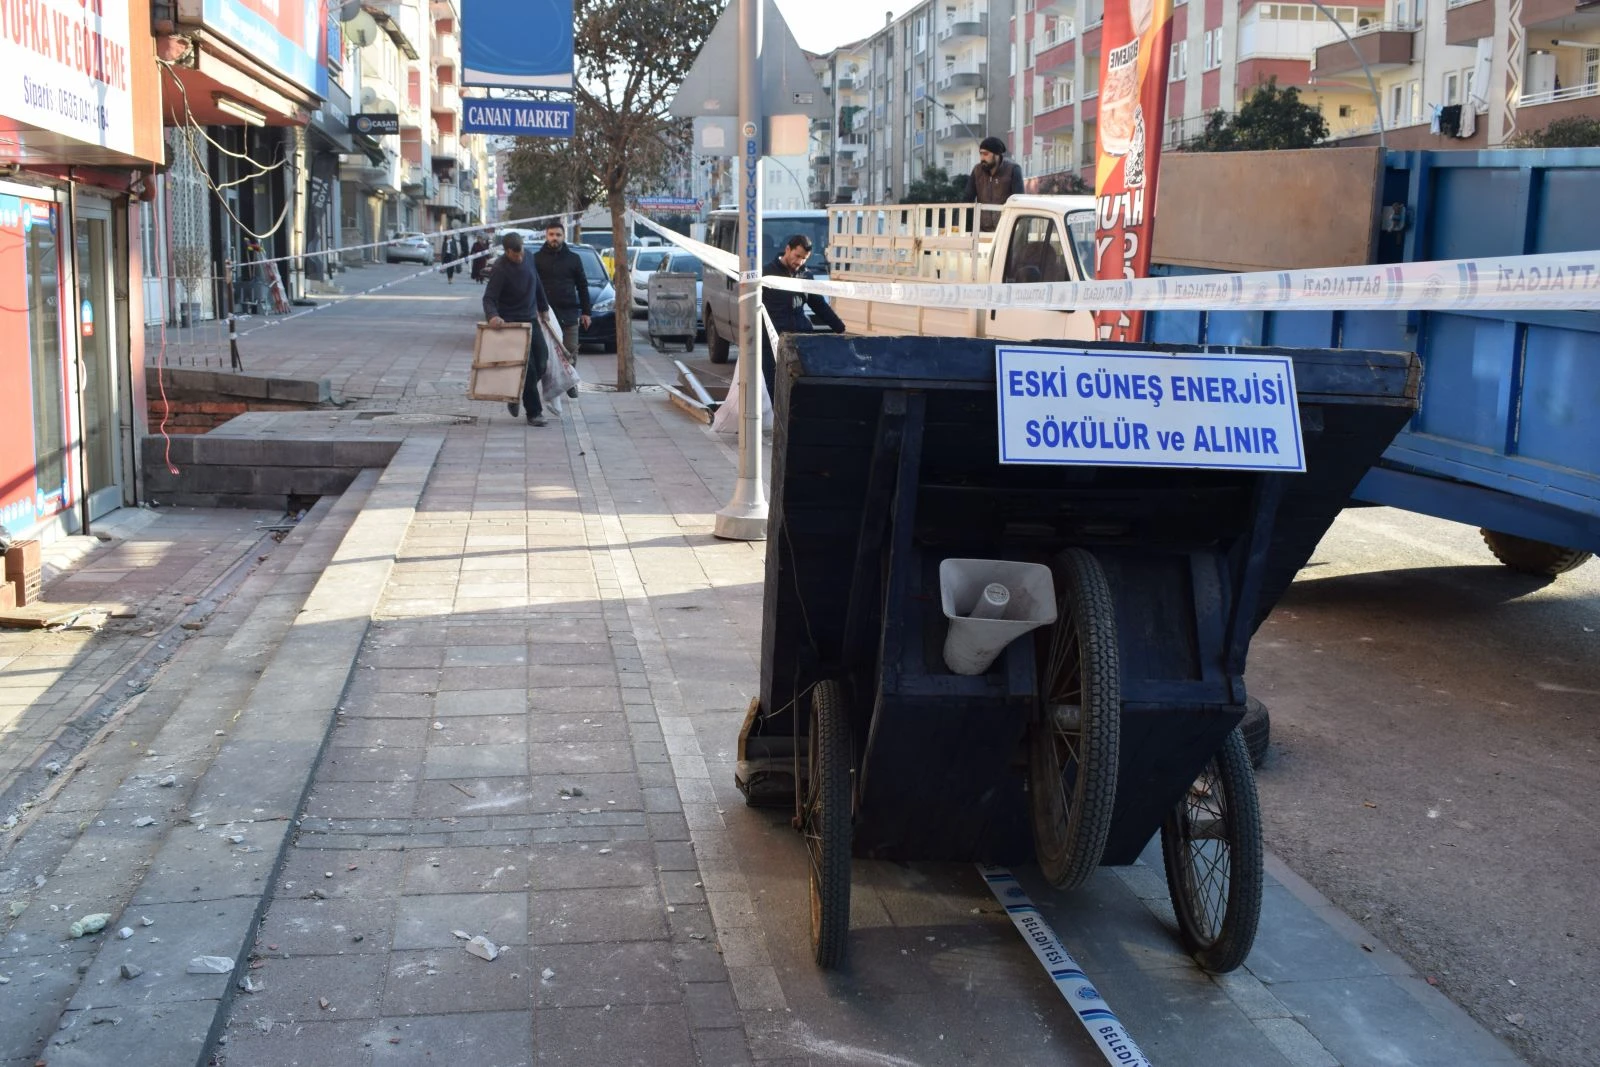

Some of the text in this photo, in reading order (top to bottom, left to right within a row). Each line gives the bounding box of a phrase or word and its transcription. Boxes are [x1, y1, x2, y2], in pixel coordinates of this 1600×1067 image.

[0, 0, 126, 92] YUFKA VE GÖZLEME
[58, 87, 78, 121] 0535
[372, 120, 398, 128] CASATI
[468, 106, 570, 130] CANAN MARKET
[1008, 366, 1286, 408] ESKİ GÜNEŞ ENERJİSİ
[1025, 415, 1280, 455] SÖKÜLÜR ve ALINIR
[1021, 916, 1067, 966] BELEDİYESİ
